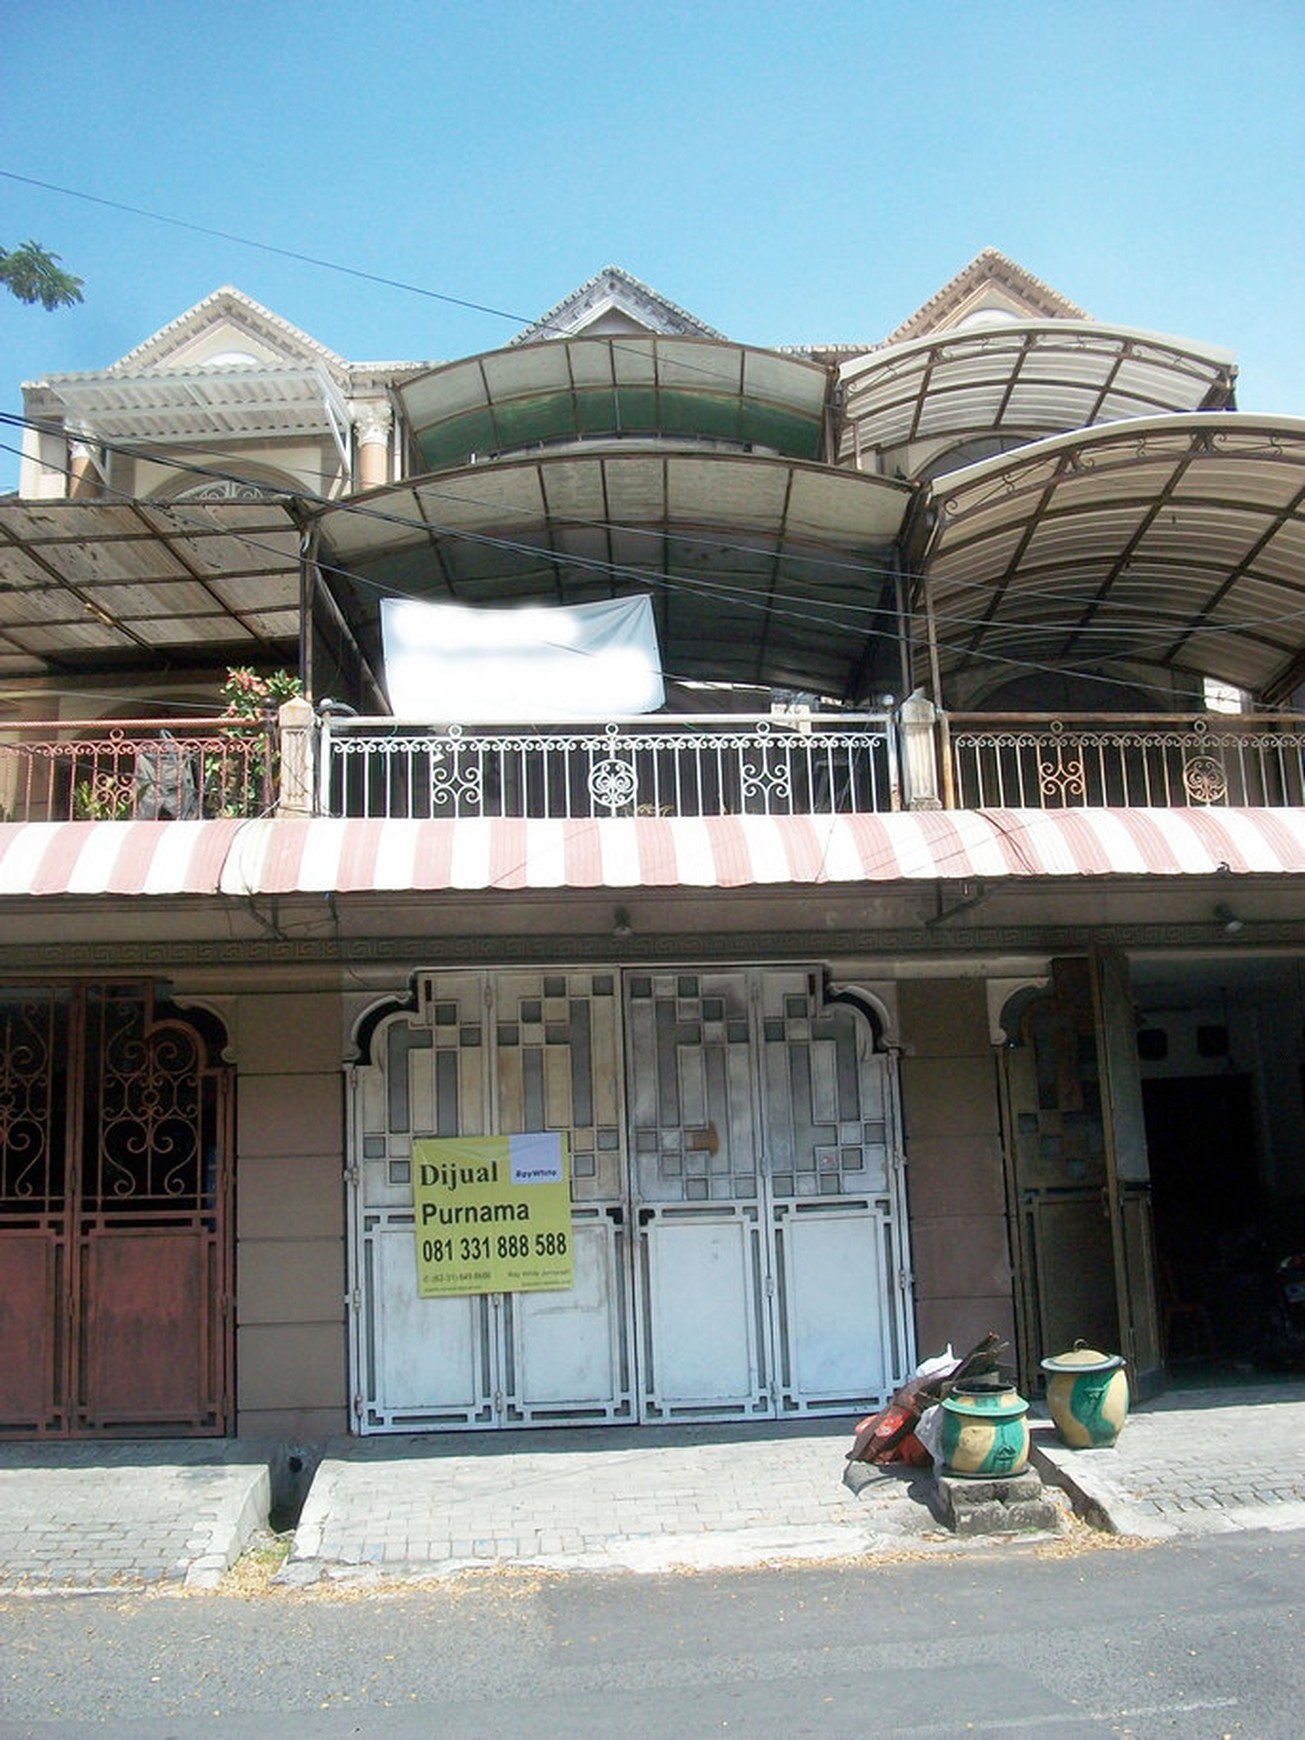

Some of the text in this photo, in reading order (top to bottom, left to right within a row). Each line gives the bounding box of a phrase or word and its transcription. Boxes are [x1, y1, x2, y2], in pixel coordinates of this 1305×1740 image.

[420, 1161, 498, 1191] Dijual
[422, 1203, 530, 1225] Purnama
[423, 1232, 567, 1262] 081 331 888 588
